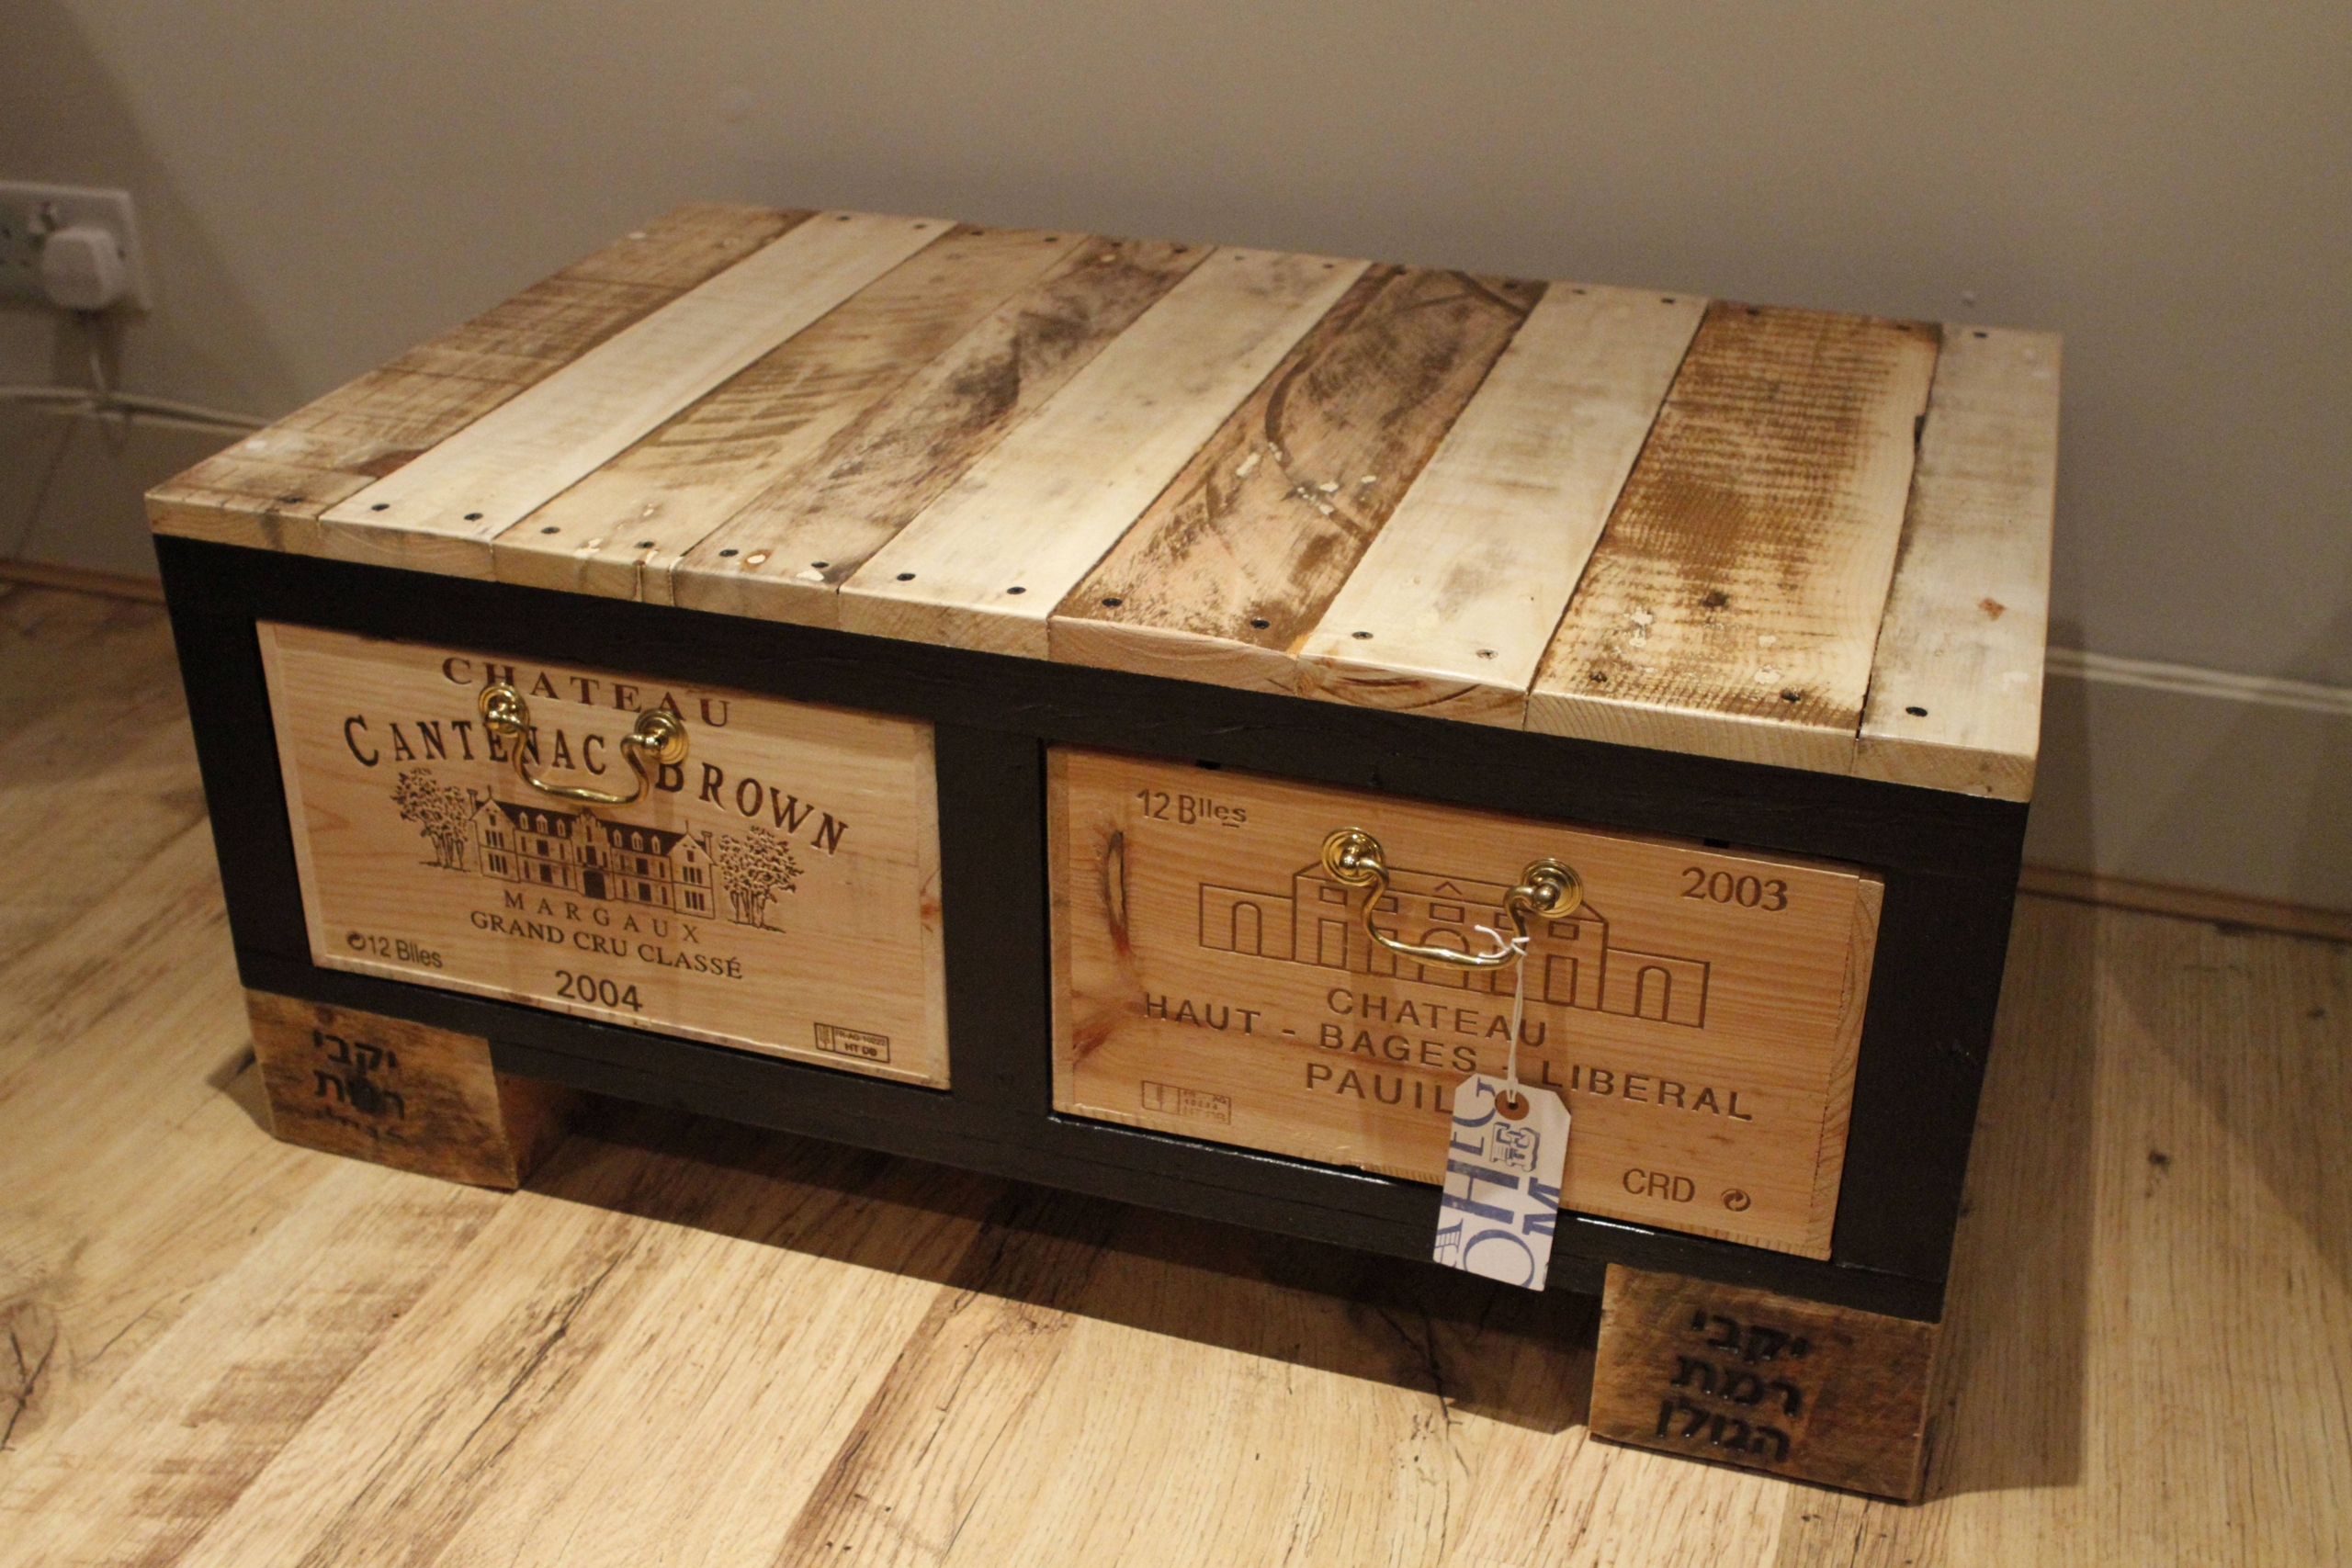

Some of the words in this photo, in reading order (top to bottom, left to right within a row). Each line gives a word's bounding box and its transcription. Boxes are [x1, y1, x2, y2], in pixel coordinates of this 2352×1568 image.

[442, 657, 730, 728] CHATEAU
[344, 715, 605, 775] CANTENAC
[655, 762, 849, 855] BROWN
[1137, 789, 1170, 821] 12
[1680, 866, 1788, 911] 2003
[504, 889, 699, 943] MARGAUX
[368, 935, 390, 958] 12
[470, 910, 565, 944] GRAND
[573, 931, 627, 957] CRU
[638, 943, 742, 979] CLASSÉ
[554, 970, 643, 1012] 2004
[1327, 987, 1546, 1047] CHATEAU
[1144, 992, 1261, 1036] HAUT
[1319, 1022, 1477, 1073] BAGES
[1542, 1060, 1753, 1122] LIBERAL
[313, 1070, 406, 1121] רת
[1306, 1063, 1453, 1114] PAUIL
[1623, 1168, 1695, 1203] CRD
